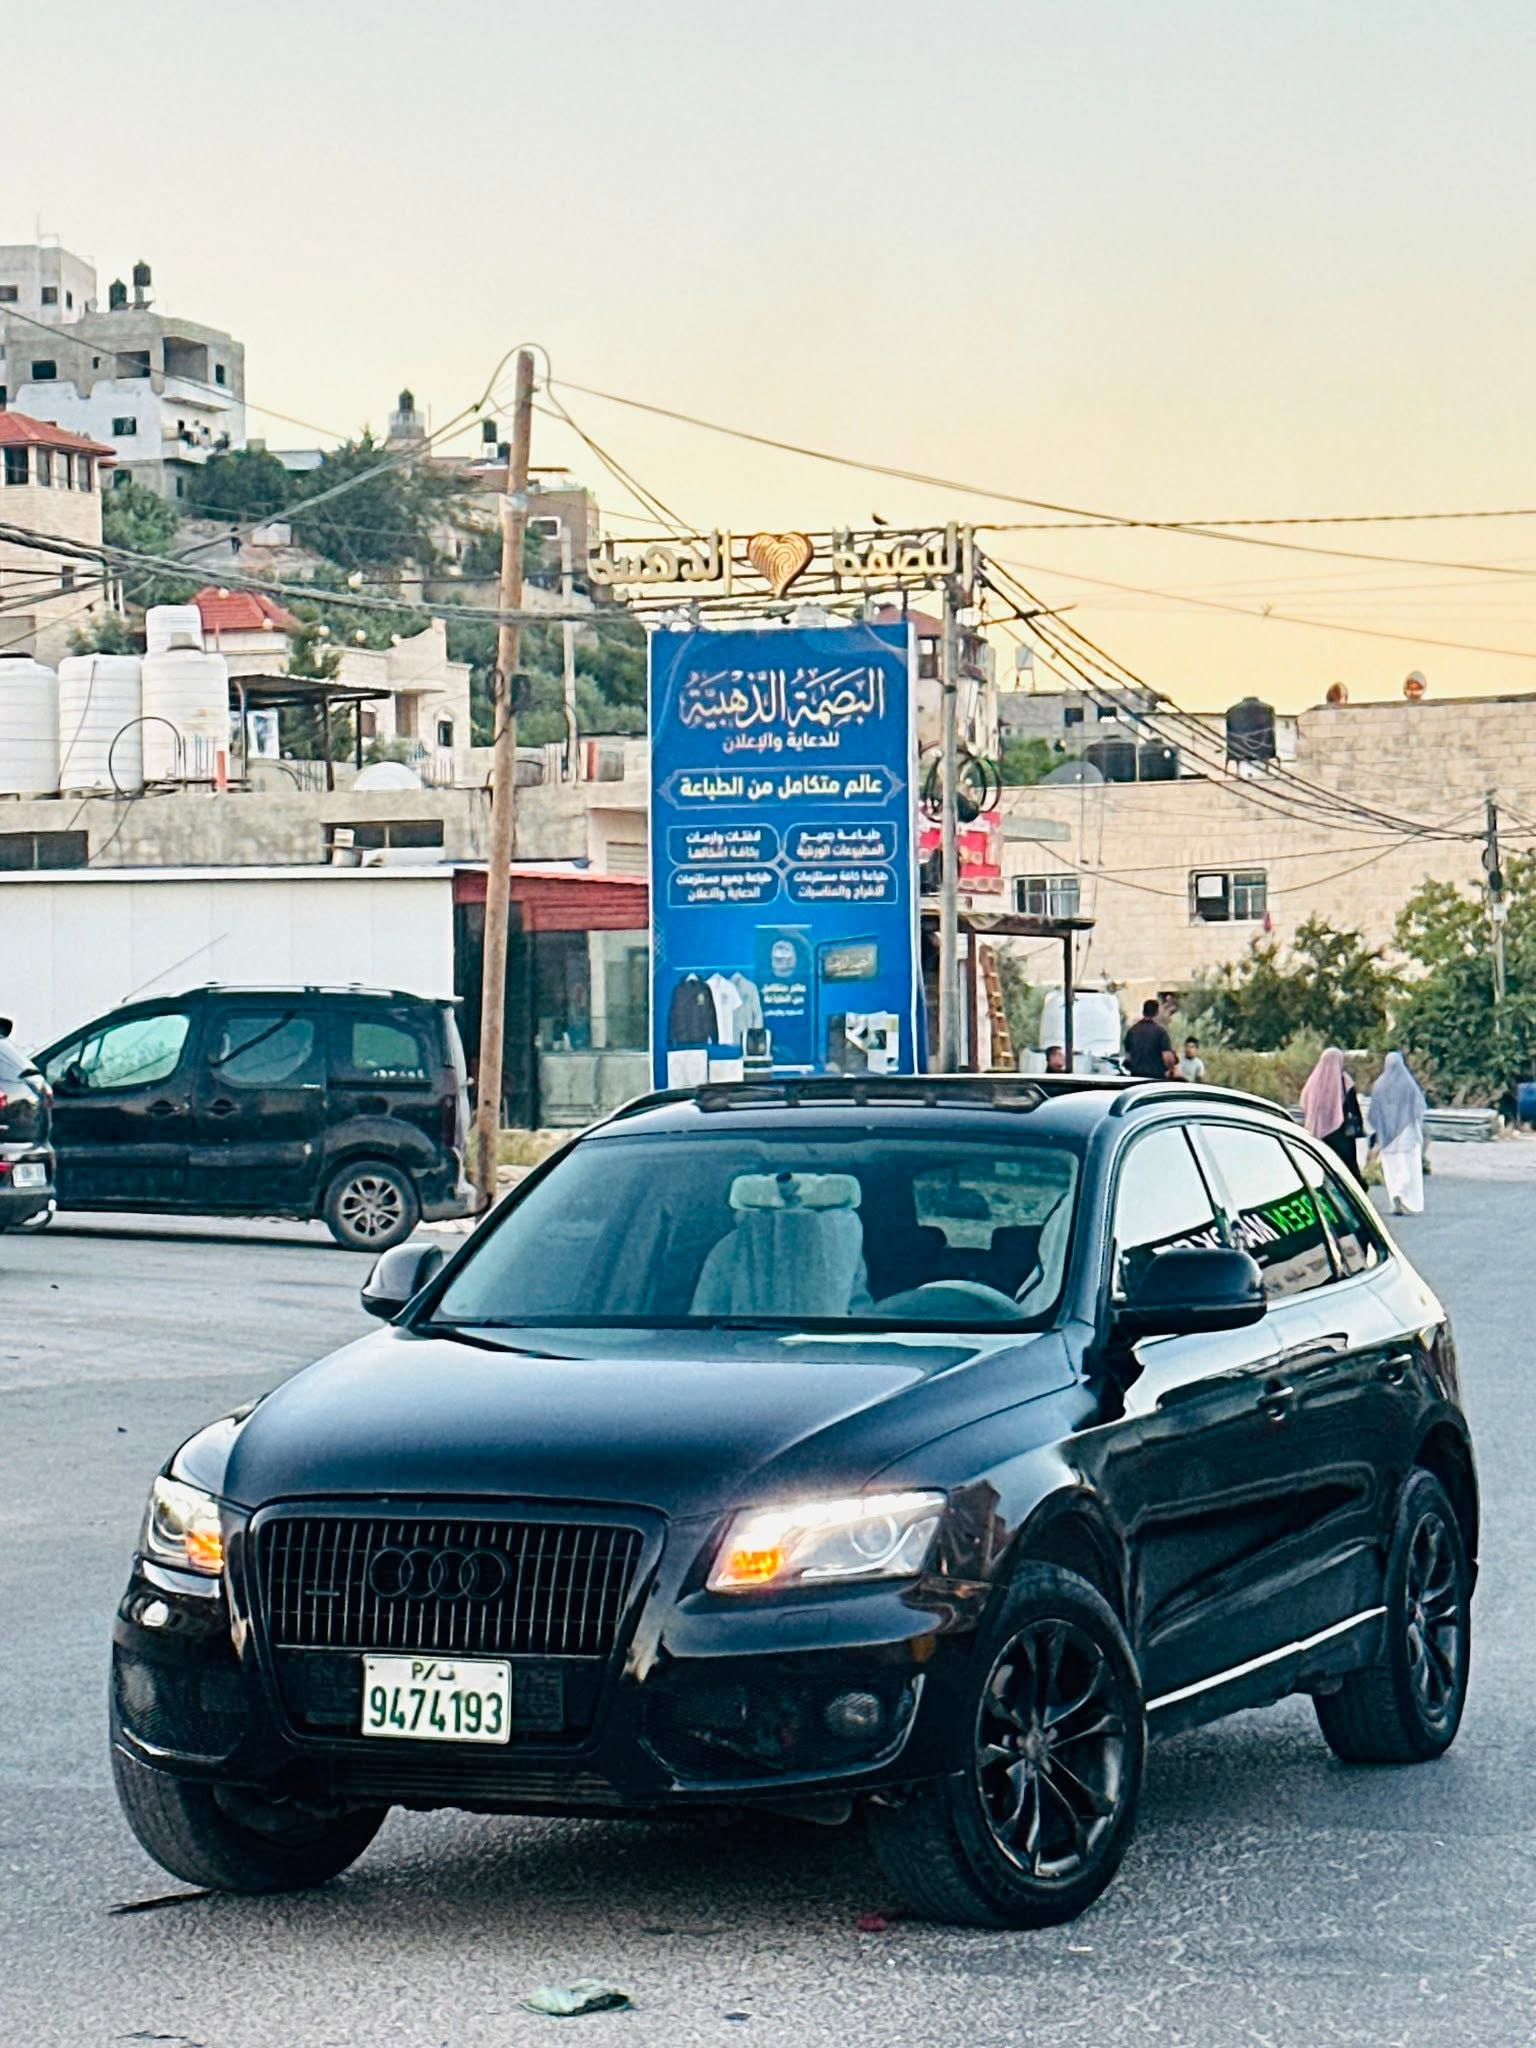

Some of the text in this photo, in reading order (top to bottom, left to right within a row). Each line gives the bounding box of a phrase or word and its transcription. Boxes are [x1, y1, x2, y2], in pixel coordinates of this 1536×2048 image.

[786, 731, 840, 752] للدعاية
[680, 774, 883, 802] عالم متكامل من الطباعة
[369, 1685, 503, 1734] 9474193
